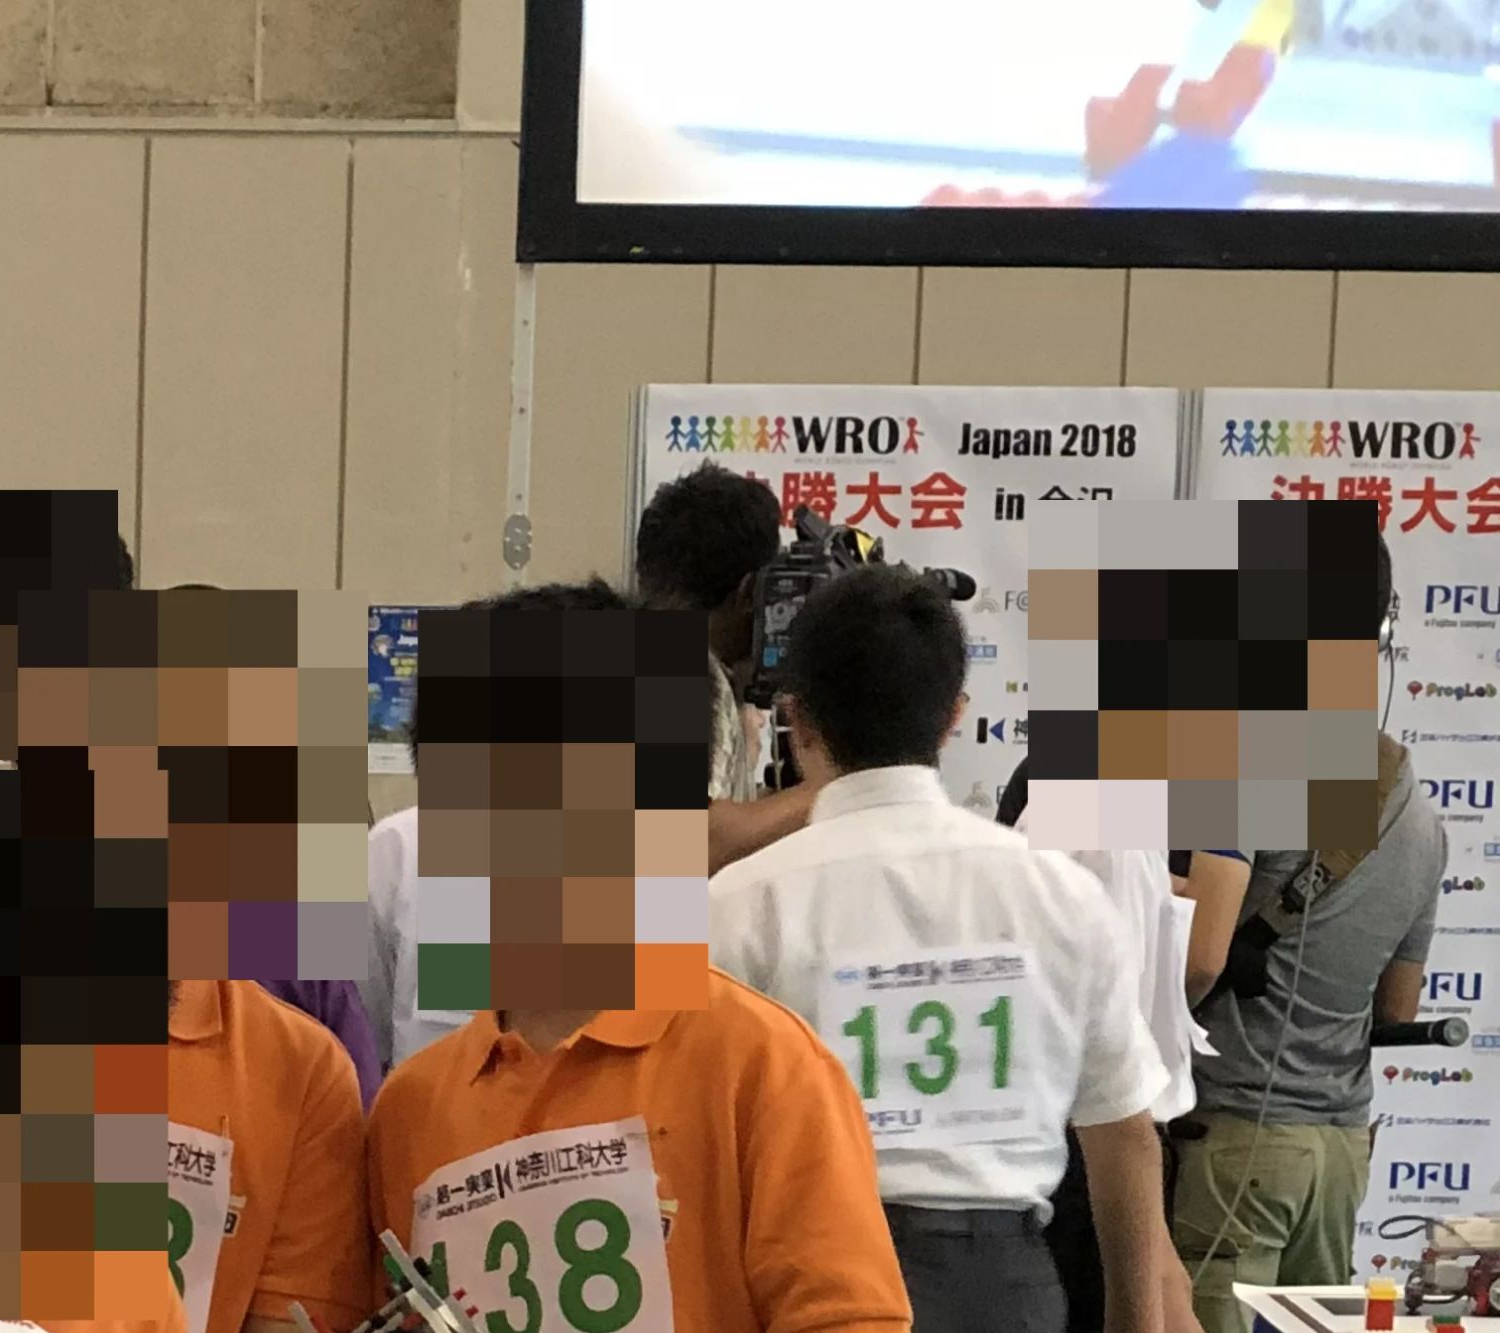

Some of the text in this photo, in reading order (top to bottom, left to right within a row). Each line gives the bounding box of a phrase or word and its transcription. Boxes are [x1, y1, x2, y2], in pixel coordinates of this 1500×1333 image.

[792, 416, 1137, 459] WRO Japan 2018
[1348, 420, 1456, 460] WRO
[745, 470, 967, 530] 勝大会
[995, 487, 1025, 520] in
[1425, 585, 1500, 615] PFU
[1424, 972, 1482, 1001] FU
[842, 995, 1012, 1100] 131
[1402, 1067, 1474, 1086] ProgLab
[1389, 1161, 1471, 1192] PFU
